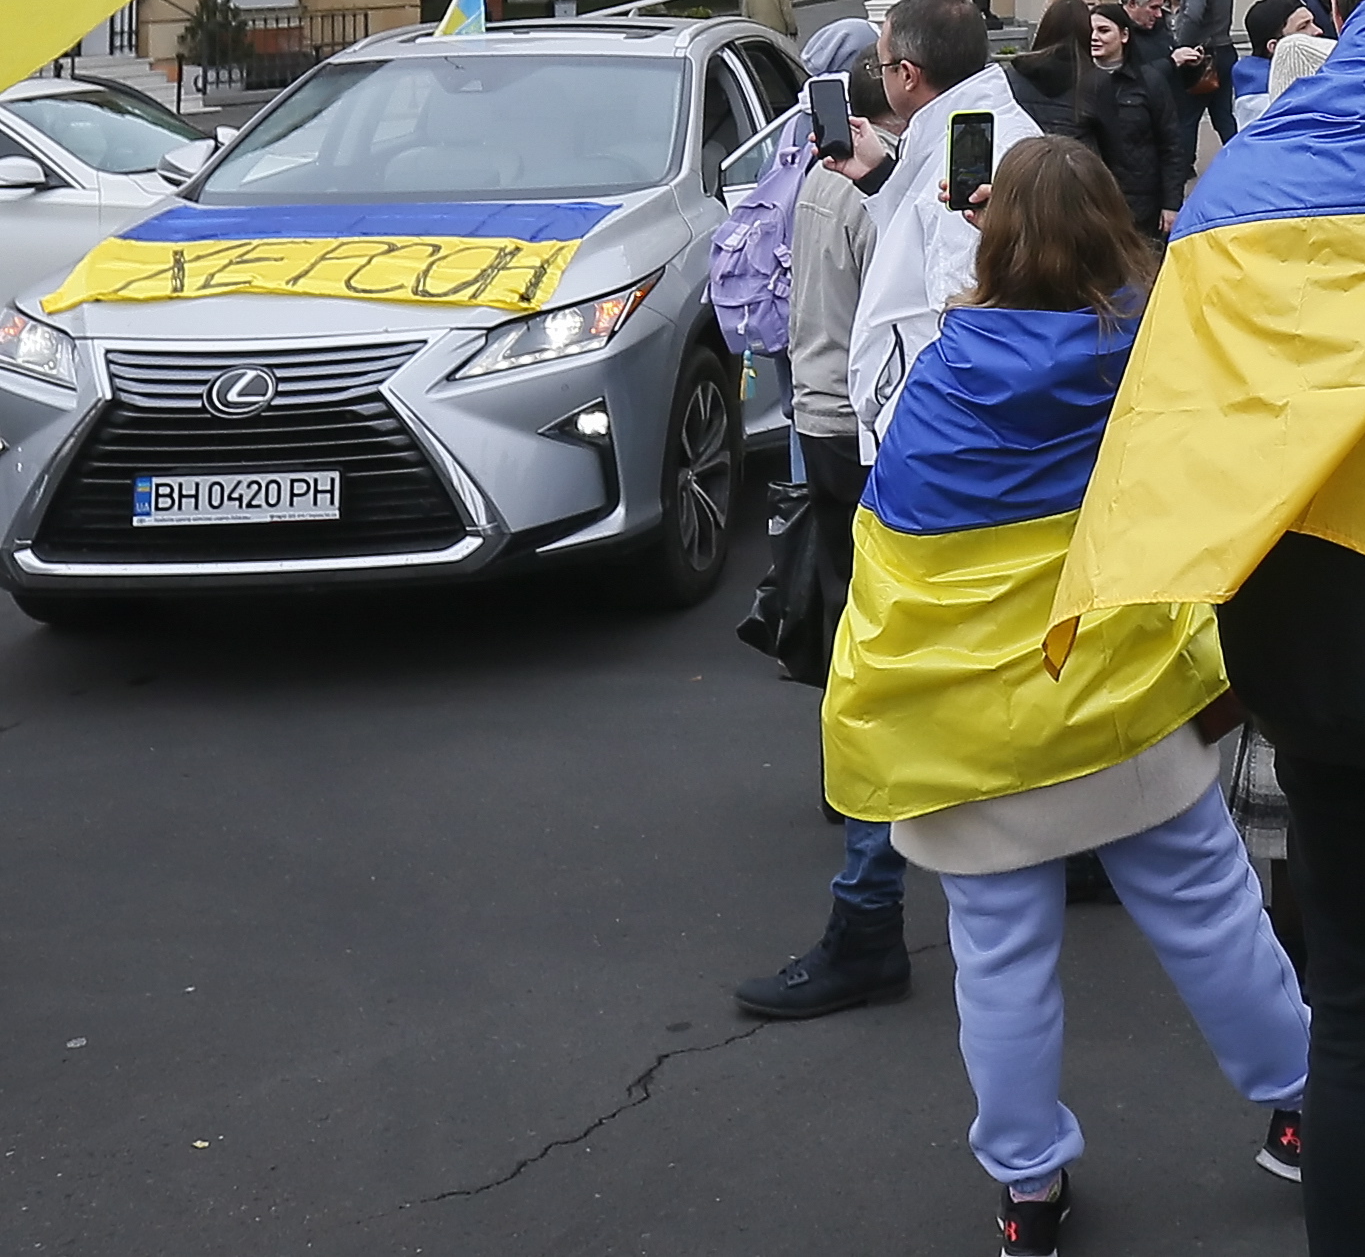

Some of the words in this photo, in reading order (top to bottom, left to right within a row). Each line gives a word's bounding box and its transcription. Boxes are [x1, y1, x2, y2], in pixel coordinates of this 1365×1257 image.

[113, 241, 564, 303] ХЕРСОН
[153, 481, 200, 512] BH
[207, 479, 282, 510] 0420
[289, 476, 336, 508] PH
